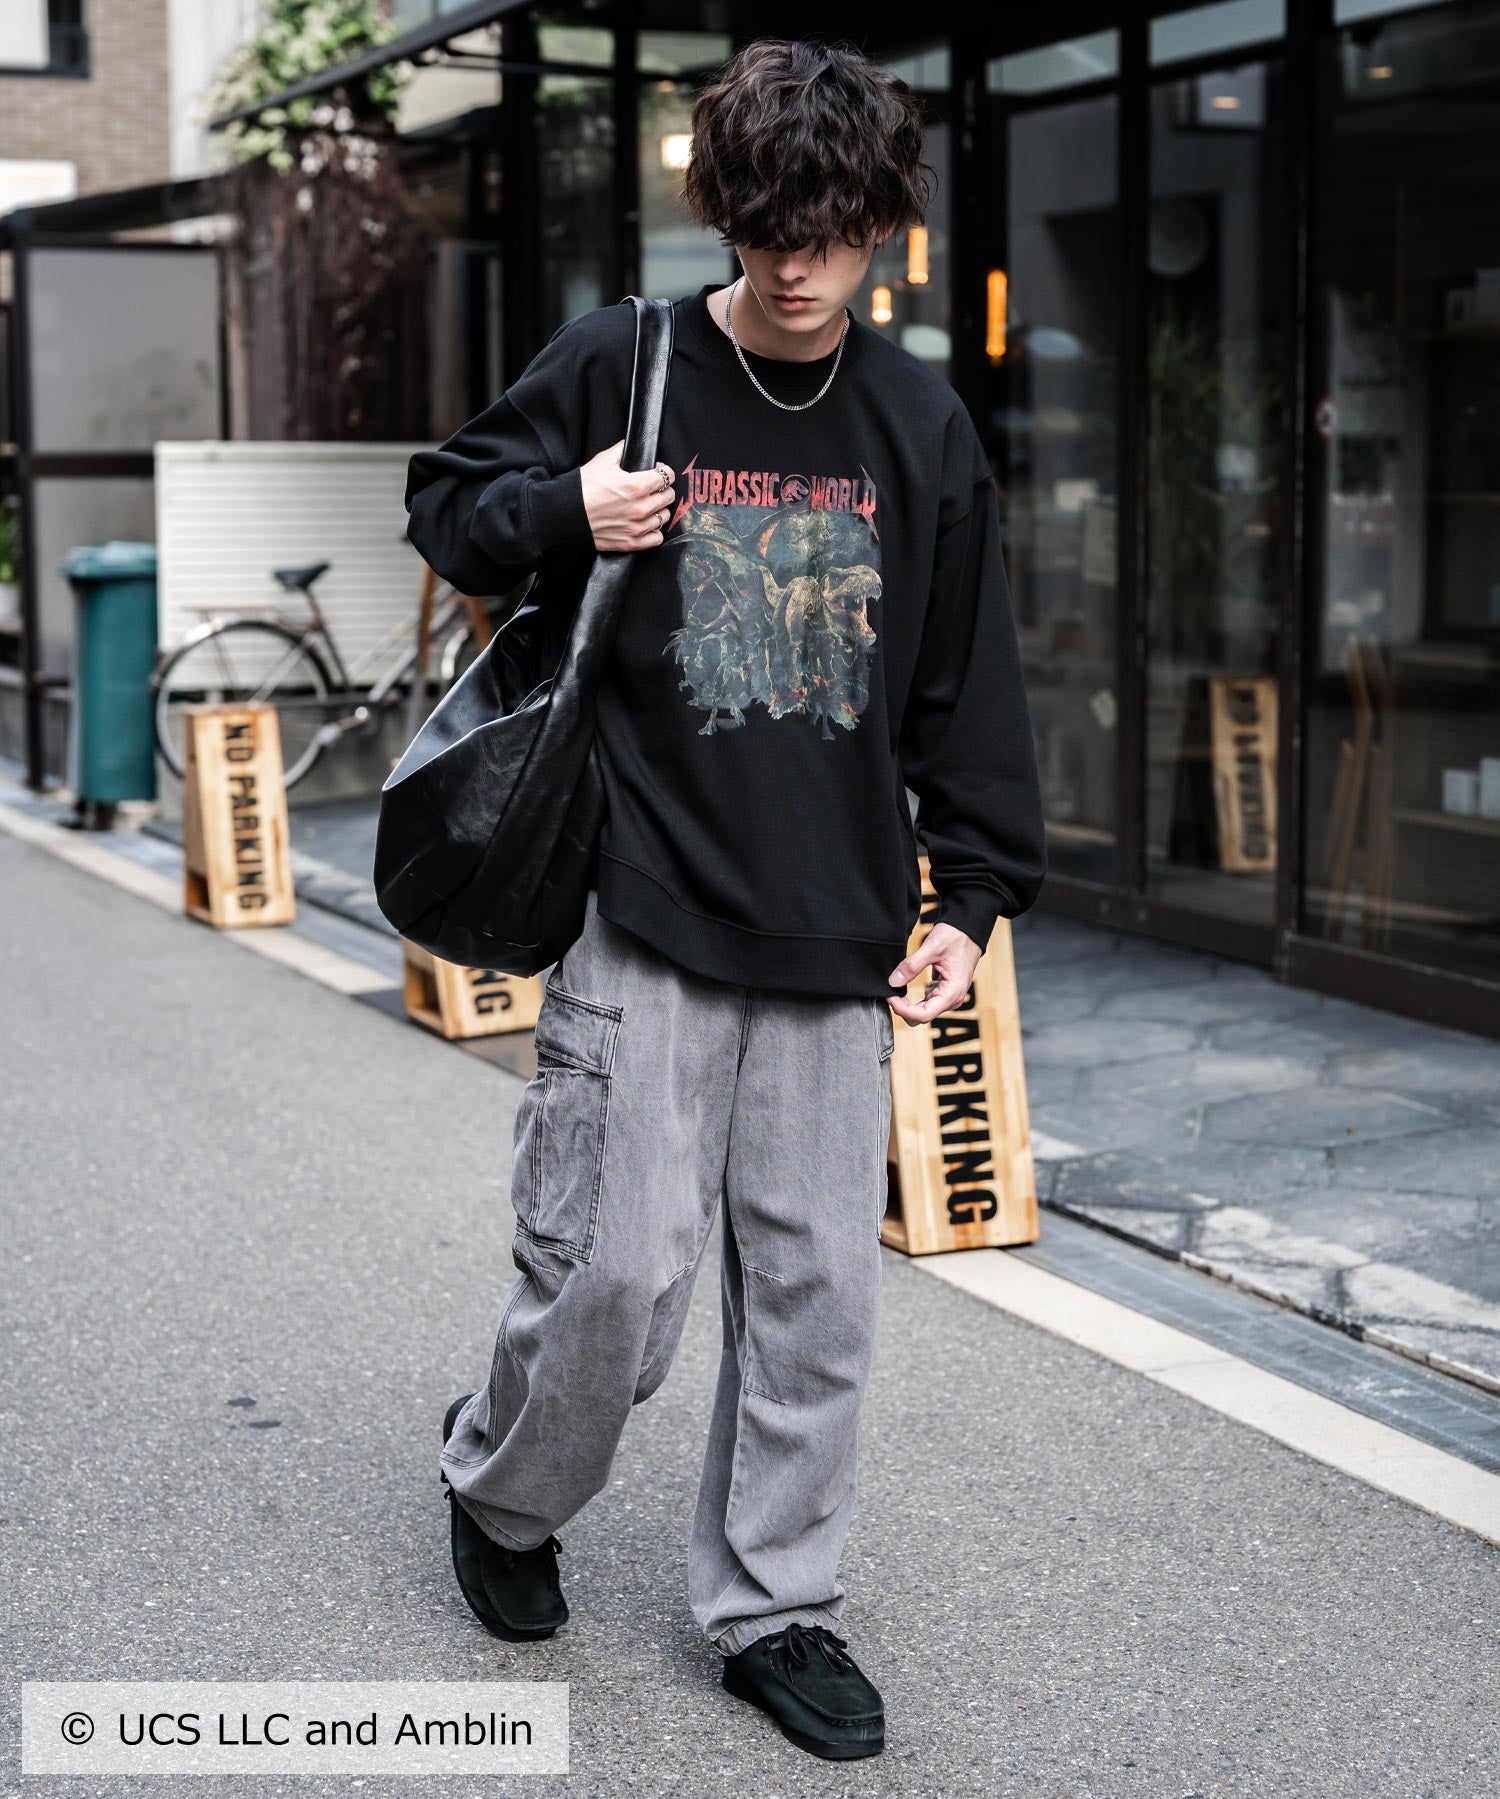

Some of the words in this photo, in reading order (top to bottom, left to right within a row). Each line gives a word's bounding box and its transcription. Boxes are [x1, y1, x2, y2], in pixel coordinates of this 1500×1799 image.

[668, 453, 780, 532] JURASSIC
[811, 463, 880, 541] WORLD
[224, 722, 255, 763] NO
[229, 775, 267, 910] PARKING
[930, 981, 998, 1226] ARKING
